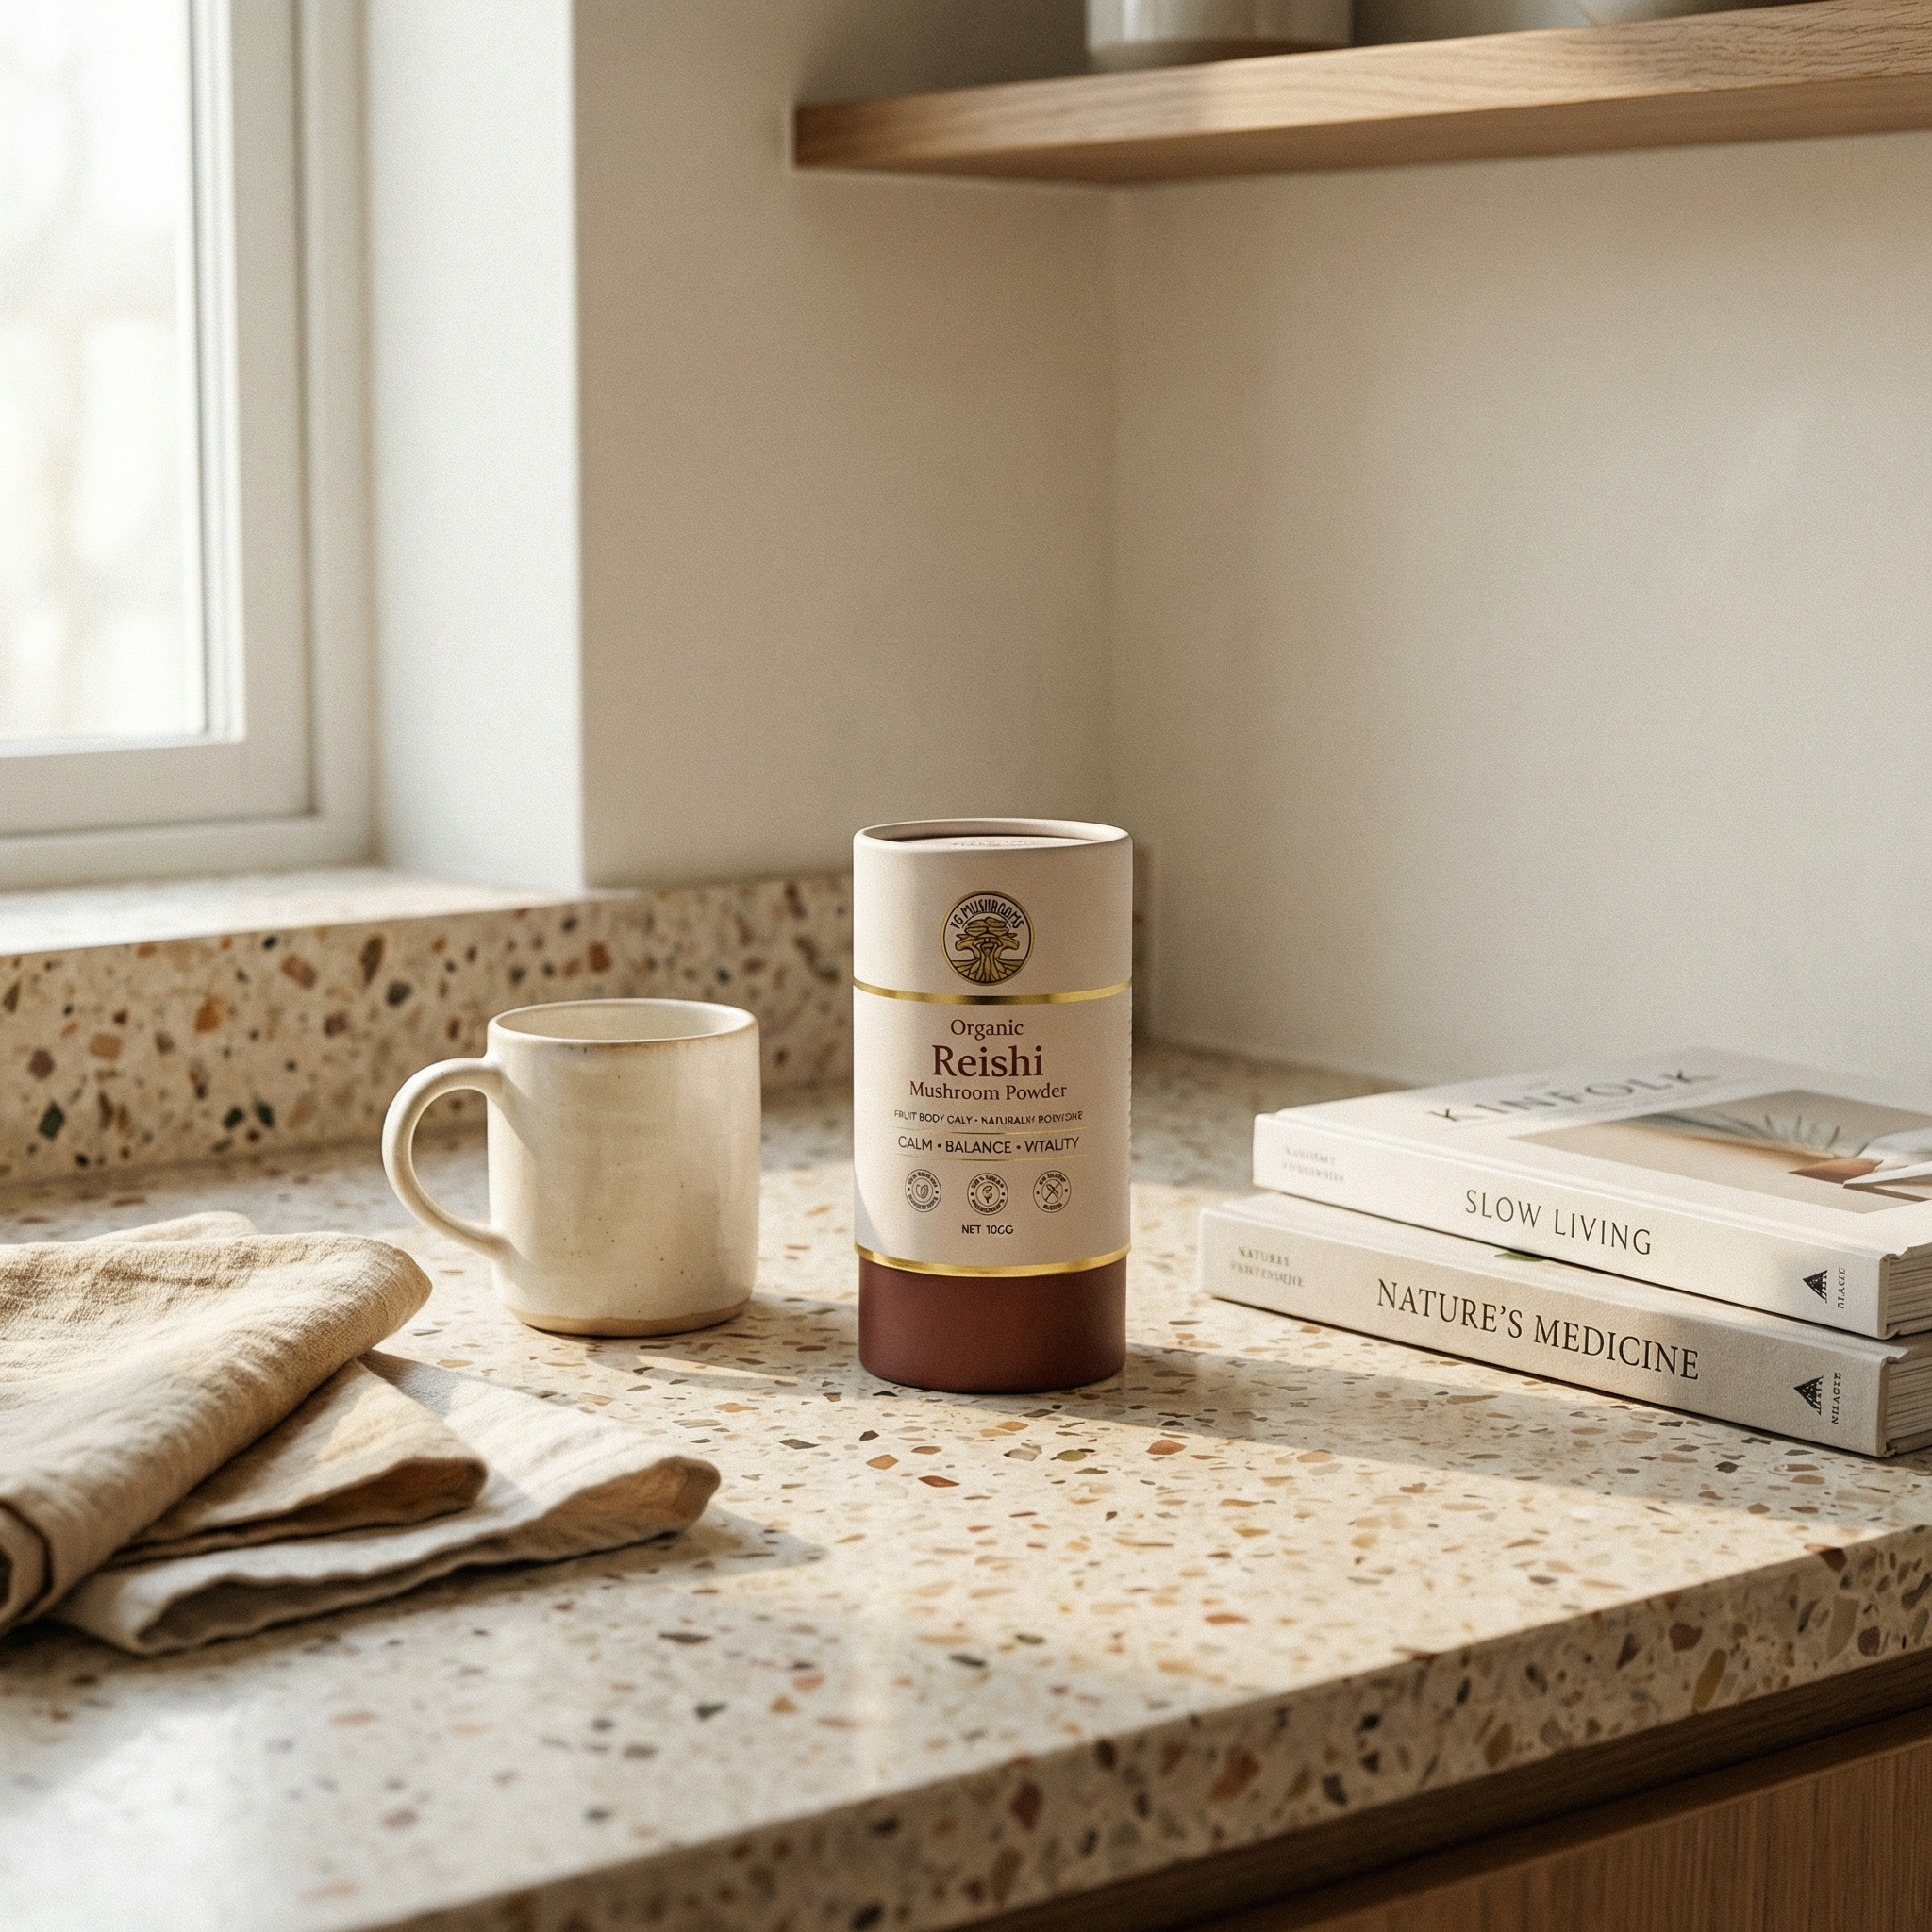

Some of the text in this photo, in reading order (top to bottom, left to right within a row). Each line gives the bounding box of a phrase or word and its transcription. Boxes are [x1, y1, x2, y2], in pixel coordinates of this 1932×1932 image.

[950, 1019, 1024, 1041] Organic
[931, 1044, 1044, 1077] Reishi
[909, 1080, 1068, 1100] Mushroom Powder
[894, 1110, 918, 1121] FRUIT
[919, 1112, 945, 1123] BODY
[897, 1135, 1080, 1154] CALM BALANCE VITALITY
[961, 1224, 982, 1234] NET
[1465, 1189, 1652, 1255] SLOW LIVING
[1533, 1314, 1699, 1380] MEDICINE
